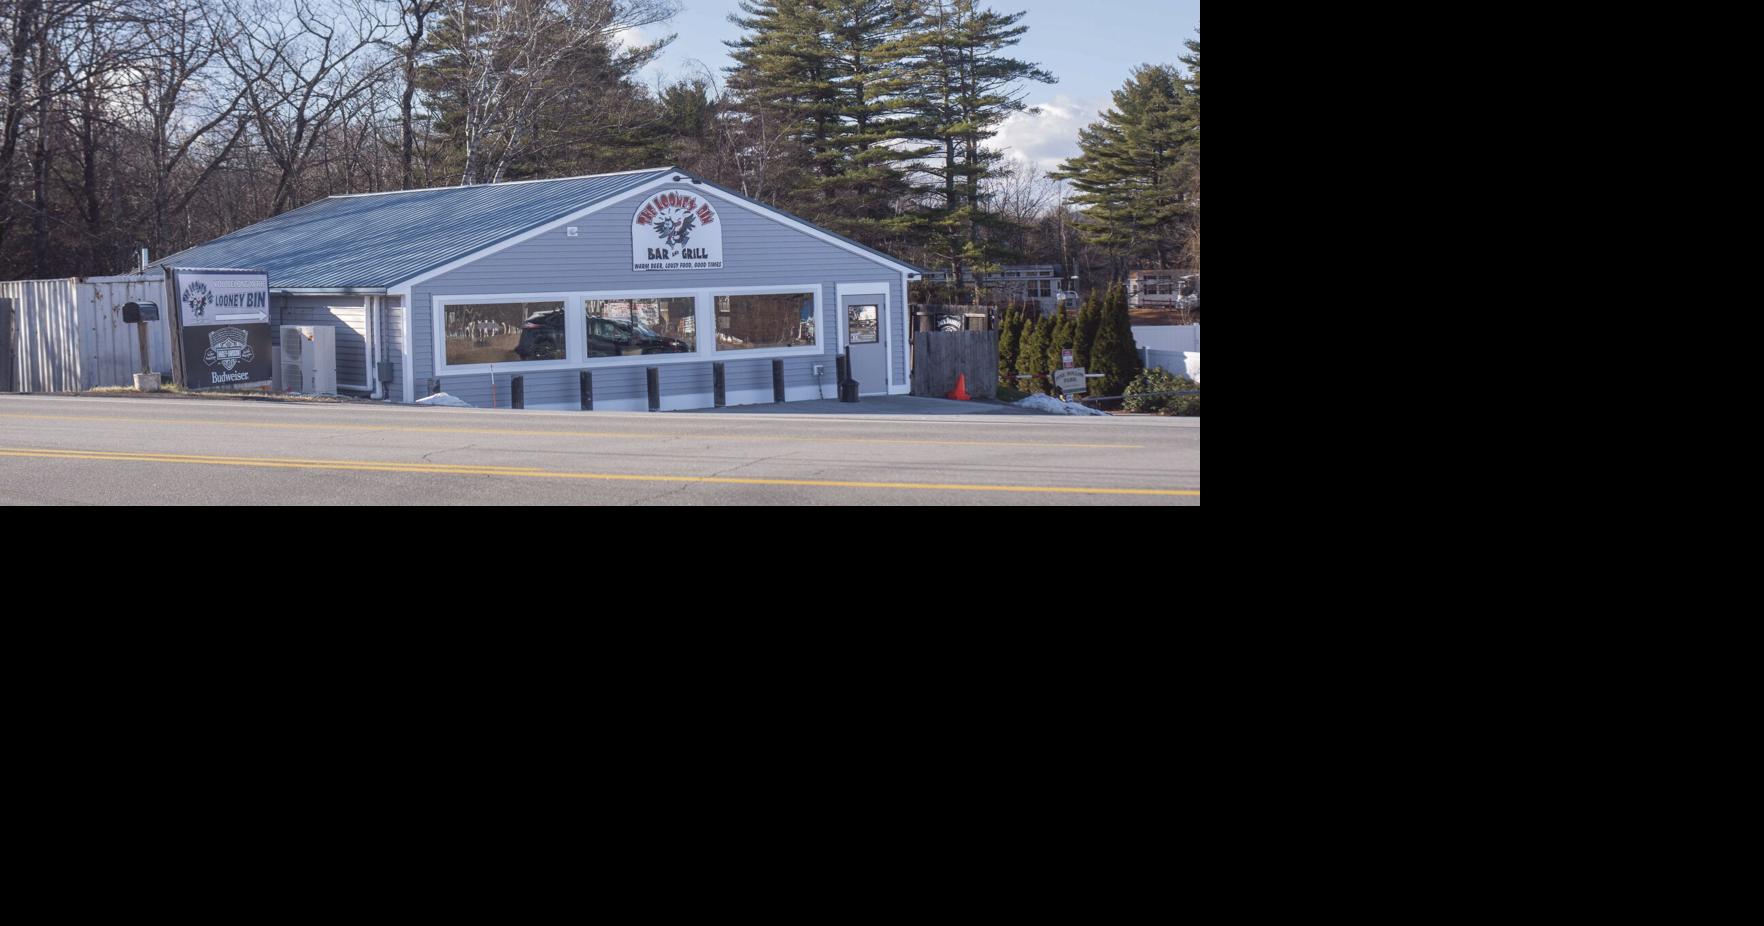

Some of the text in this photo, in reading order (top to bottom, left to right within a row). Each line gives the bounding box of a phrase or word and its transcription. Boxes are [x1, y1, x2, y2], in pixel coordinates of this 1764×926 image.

[648, 248, 669, 260] BAR
[682, 248, 708, 259] GRILL
[215, 292, 266, 308] LOONEY BIN
[211, 371, 249, 384] Budweiser
